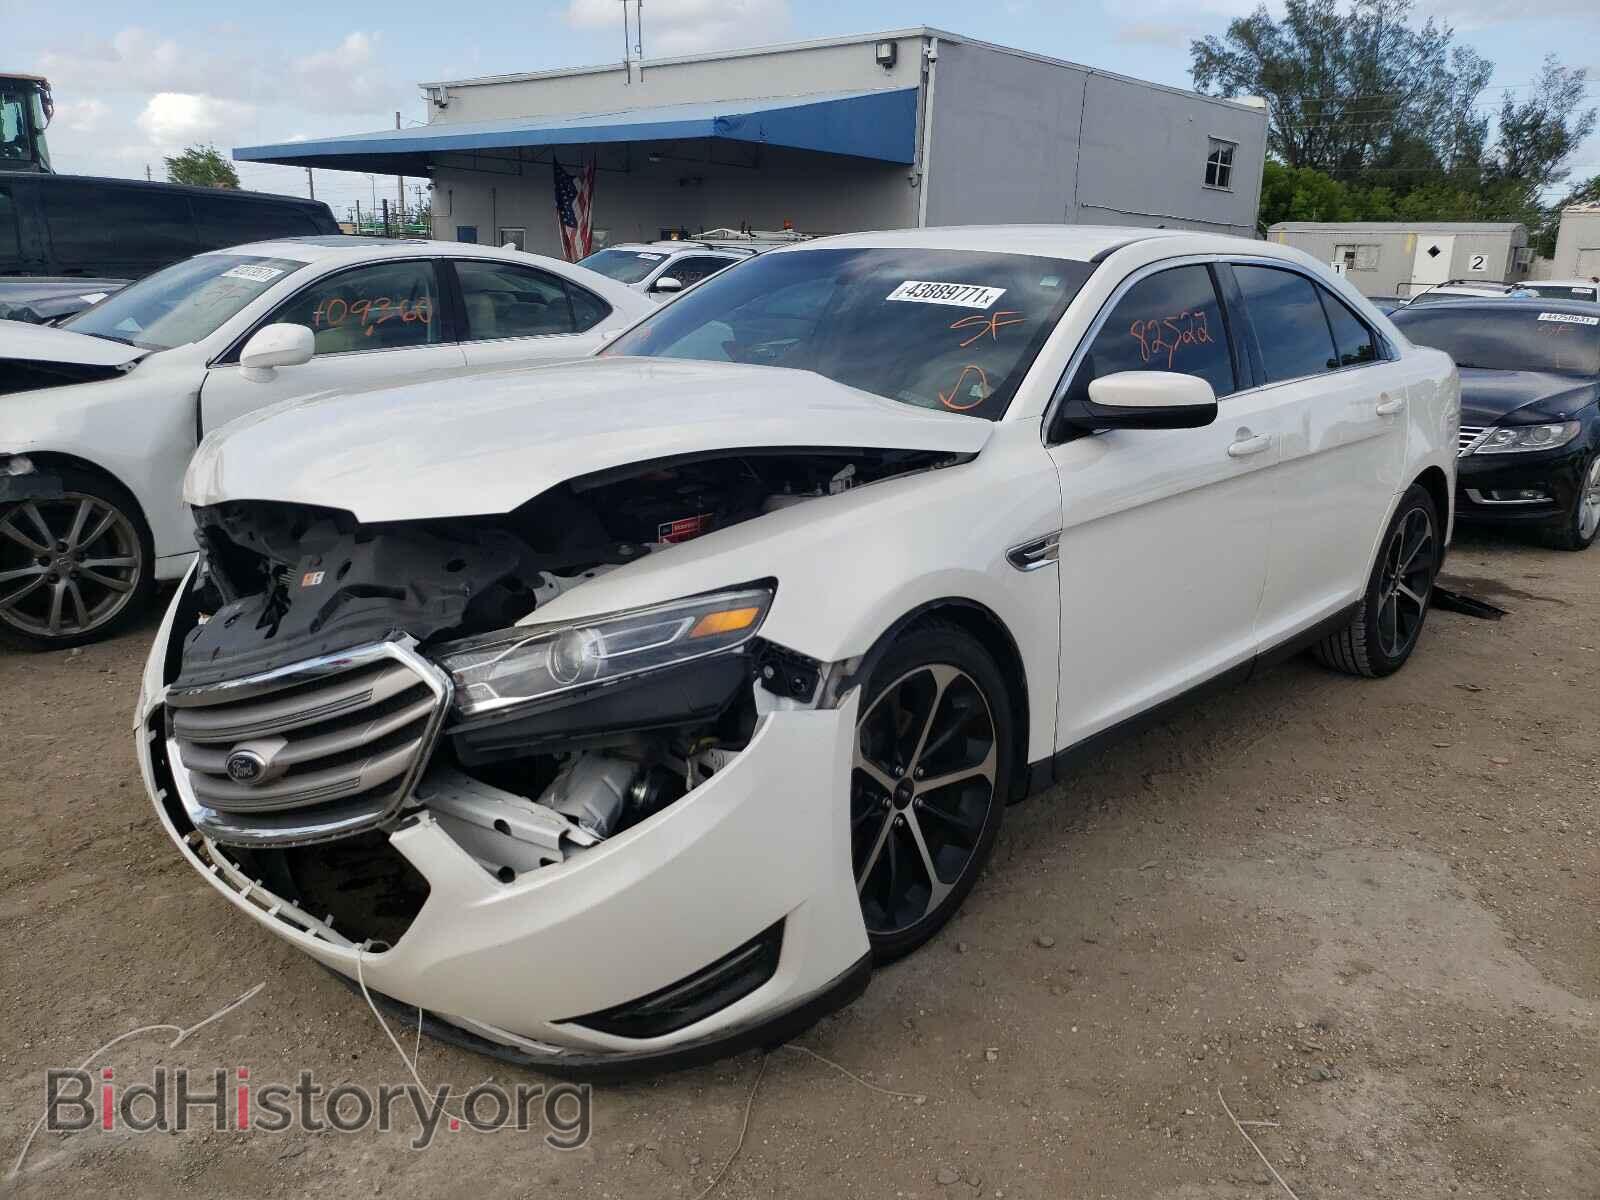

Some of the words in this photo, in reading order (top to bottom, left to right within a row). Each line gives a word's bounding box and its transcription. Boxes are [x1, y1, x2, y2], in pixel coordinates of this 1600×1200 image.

[1333, 264, 1341, 273] 1
[1471, 255, 1485, 270] 2
[232, 759, 255, 777] Ford
